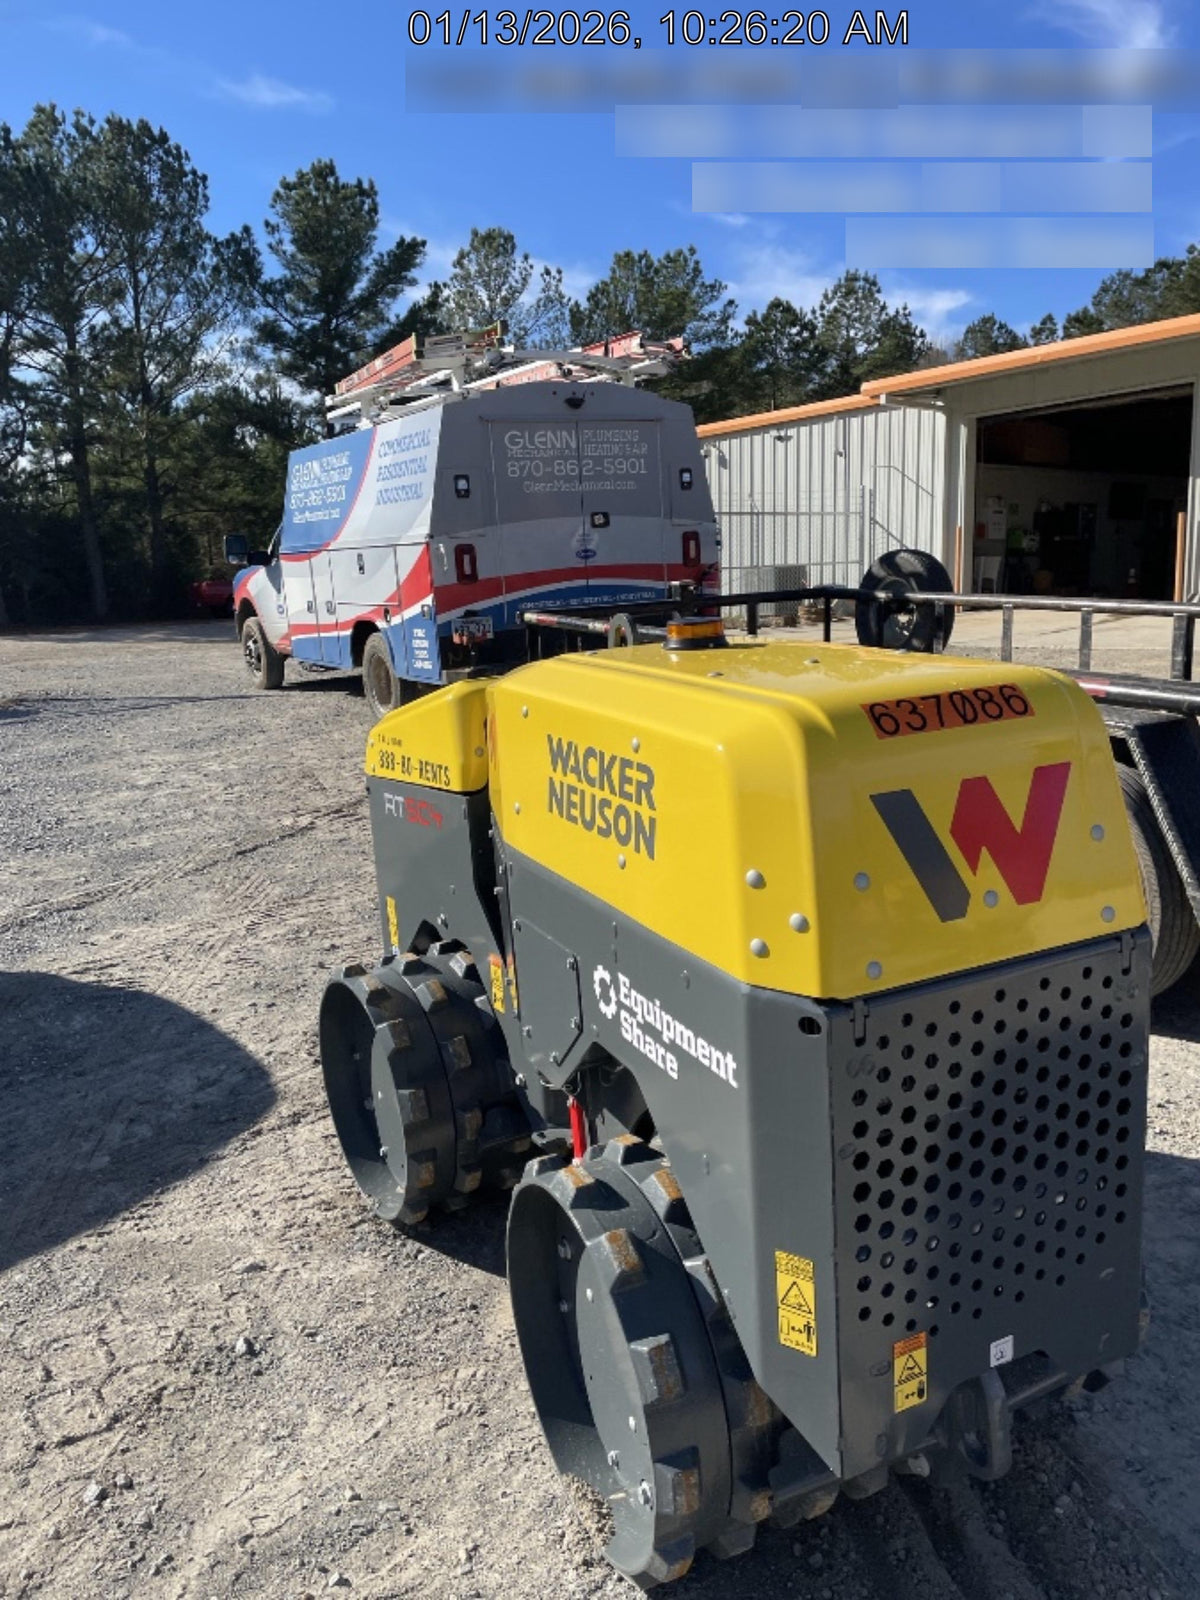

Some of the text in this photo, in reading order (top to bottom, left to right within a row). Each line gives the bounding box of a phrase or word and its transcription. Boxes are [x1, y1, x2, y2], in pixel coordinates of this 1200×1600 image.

[504, 430, 577, 449] GLENN
[583, 429, 640, 441] PLUMBING
[506, 457, 648, 477] 870-862-5901
[868, 684, 1030, 736] 637086
[546, 733, 657, 812] WACKER
[547, 776, 657, 861] NEUSON
[617, 971, 739, 1089] Equipment
[619, 1009, 679, 1080] Share
